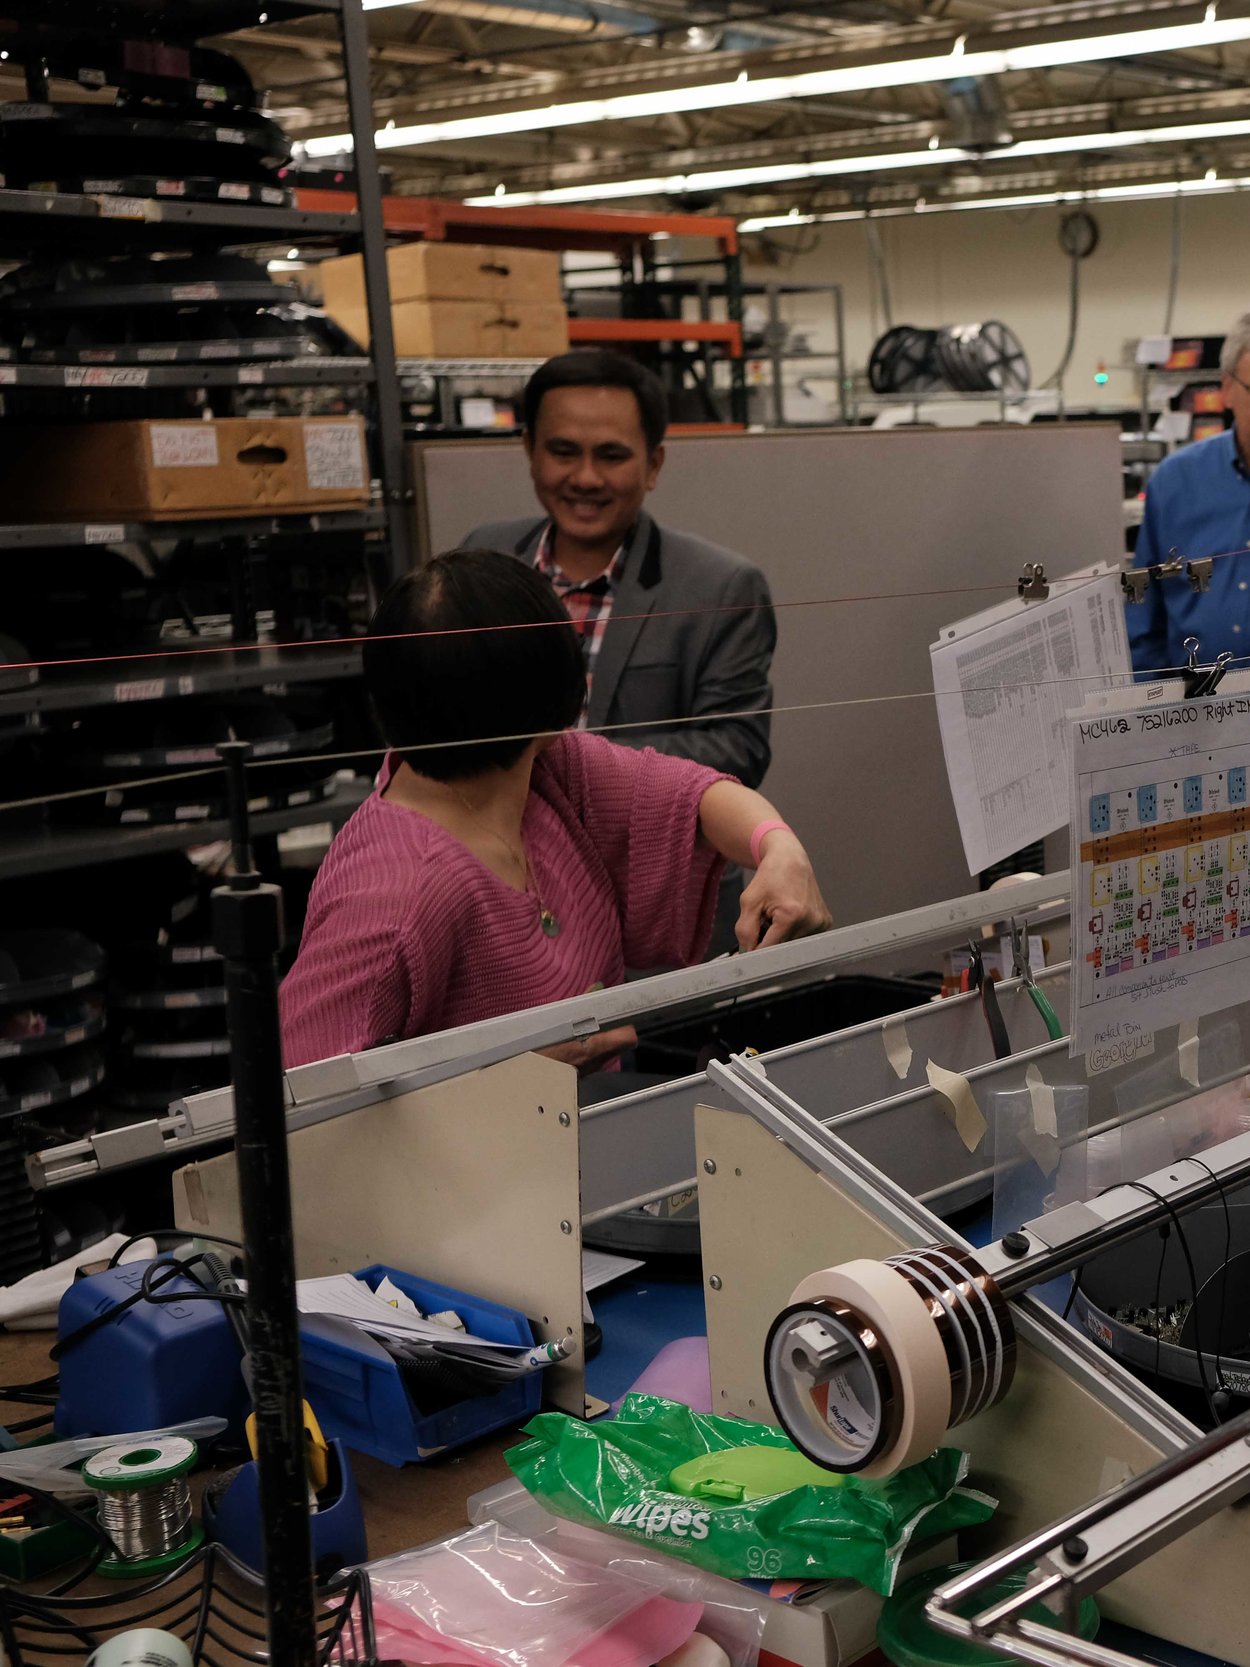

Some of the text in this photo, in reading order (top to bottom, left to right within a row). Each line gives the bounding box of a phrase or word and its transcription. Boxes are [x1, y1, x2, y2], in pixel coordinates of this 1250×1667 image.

[1079, 719, 1131, 744] MC462
[1136, 707, 1198, 733] 75216200
[1203, 702, 1235, 723] Right
[608, 1500, 711, 1540] wipes
[747, 1545, 782, 1574] 96
